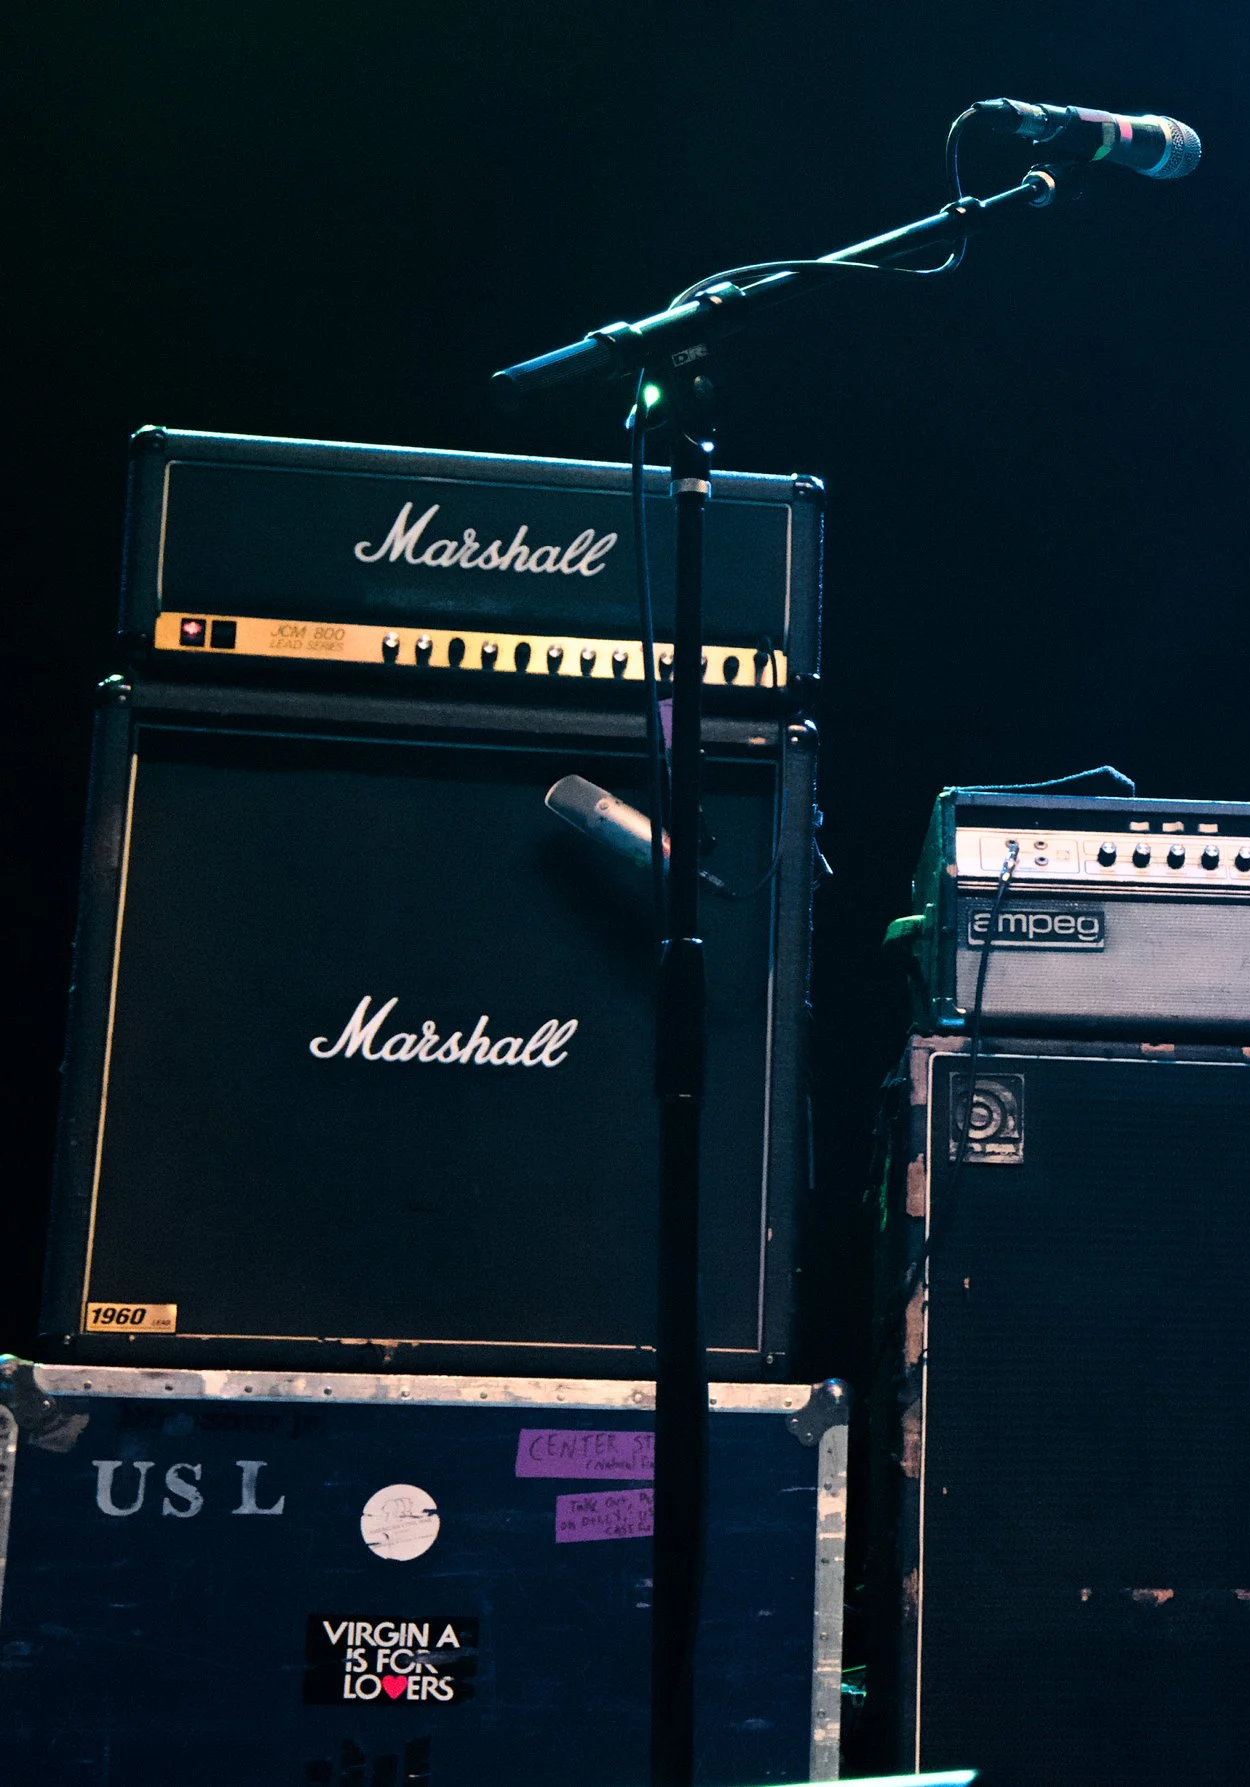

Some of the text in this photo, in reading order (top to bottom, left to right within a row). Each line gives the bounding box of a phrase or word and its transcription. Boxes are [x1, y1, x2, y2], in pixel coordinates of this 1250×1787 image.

[354, 501, 618, 577] Marshall
[269, 639, 345, 652] LEAD SERIES
[270, 623, 346, 641] JCM 800
[973, 912, 1100, 941] ampeg
[309, 995, 579, 1068] Marshall
[92, 1307, 146, 1325] 1960
[528, 1432, 617, 1462] CENTER
[345, 1647, 439, 1674] IS FOR
